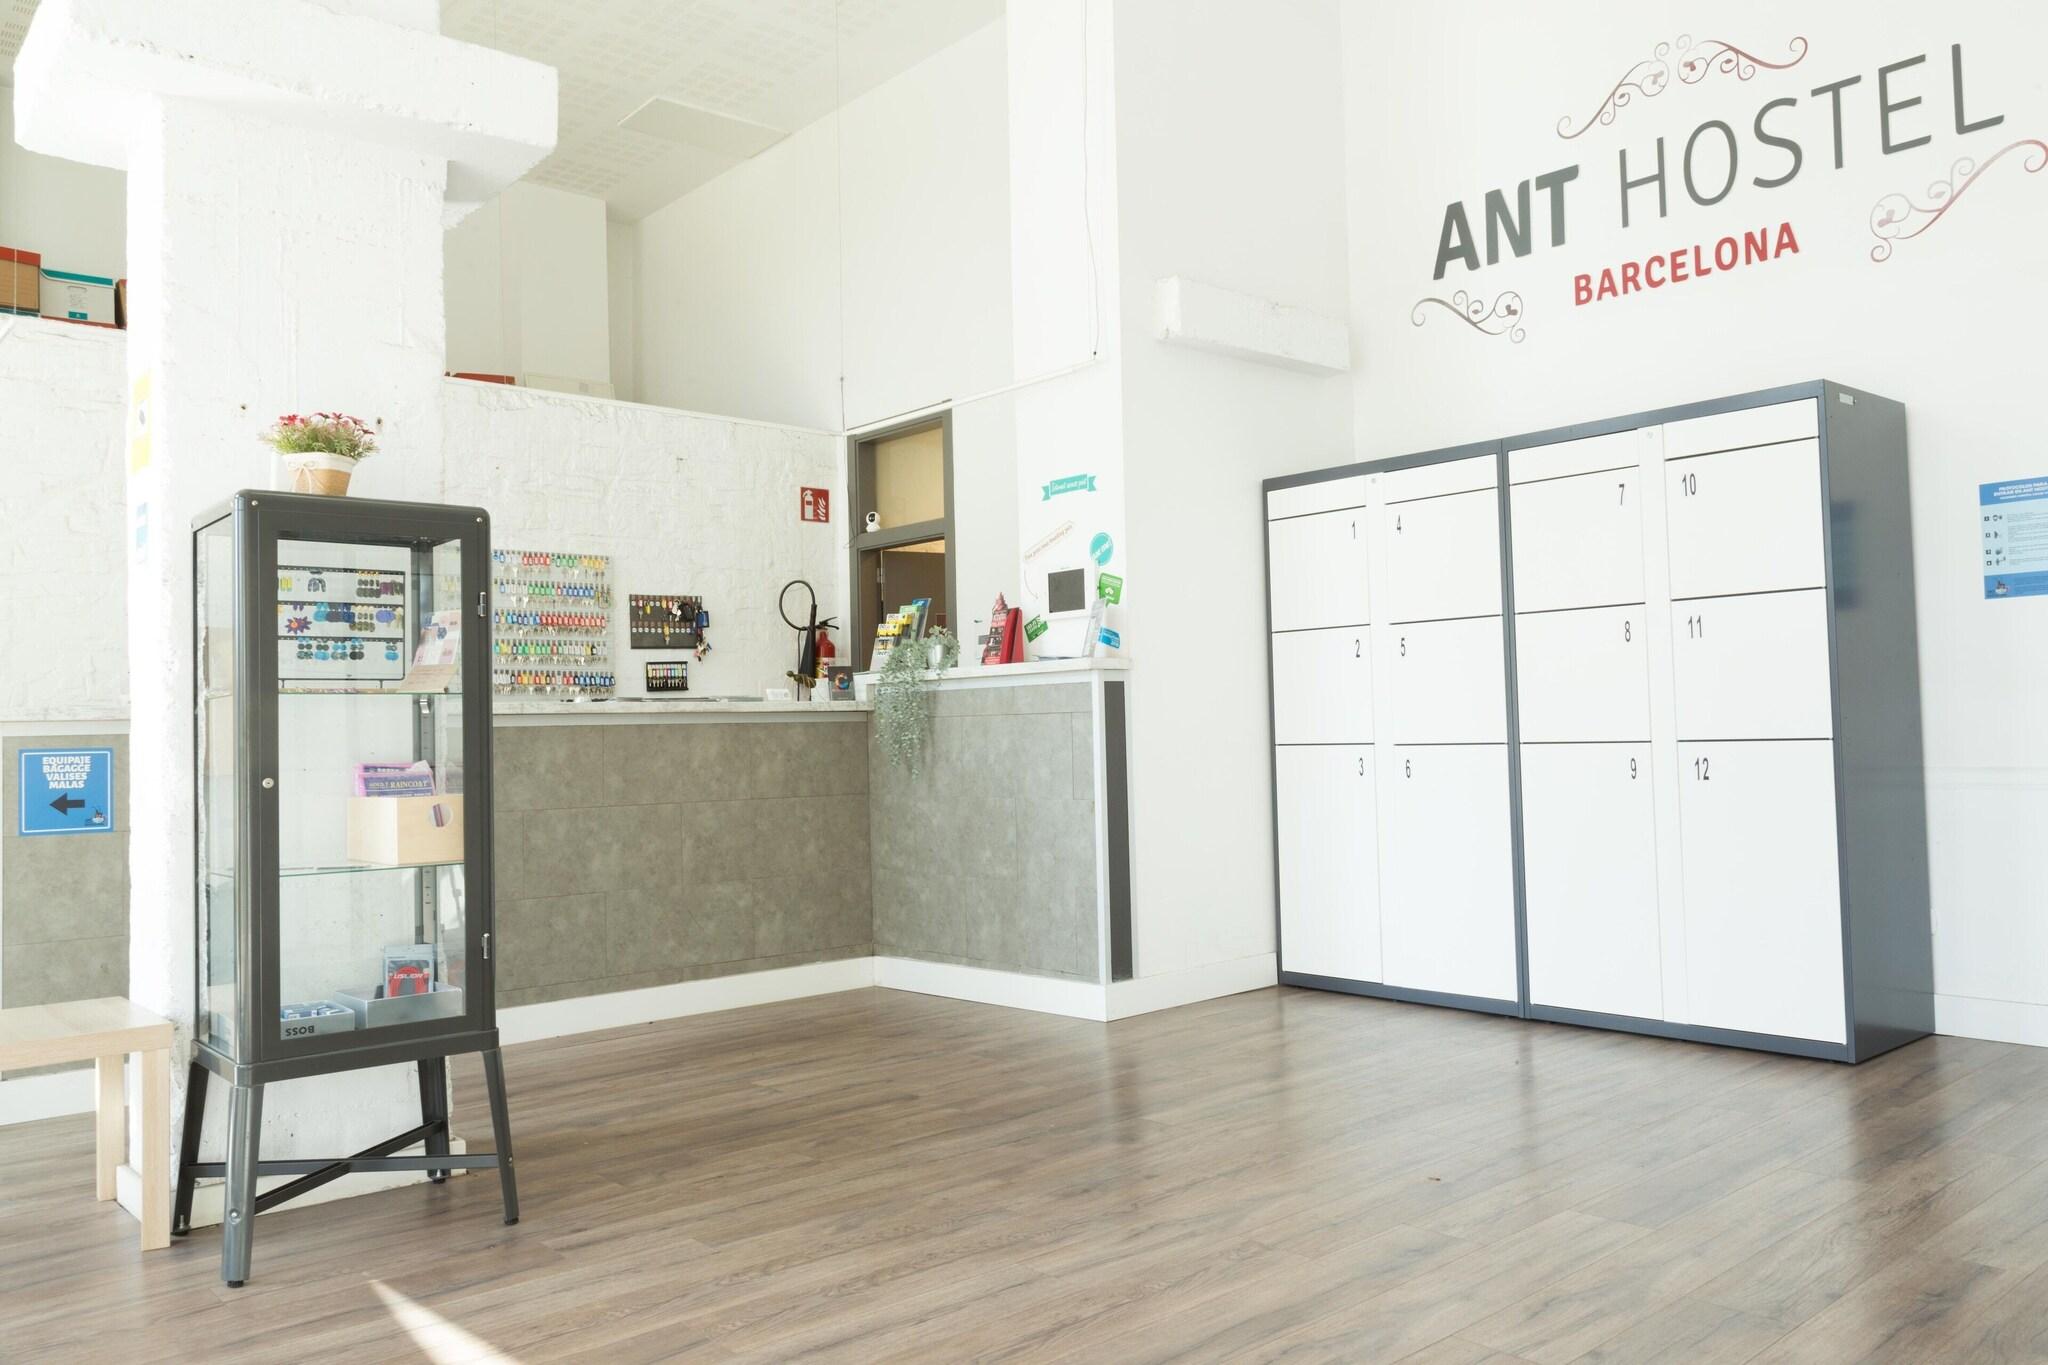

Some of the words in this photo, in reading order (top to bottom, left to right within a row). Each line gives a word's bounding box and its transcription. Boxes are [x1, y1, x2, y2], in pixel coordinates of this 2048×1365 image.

[1432, 164, 1580, 280] ANT
[1618, 43, 2005, 228] HOSTEL
[1573, 221, 1800, 306] BARCELONA
[1618, 483, 1625, 506] 7
[1682, 473, 1697, 496] 10
[1351, 521, 1356, 540] 1
[1396, 515, 1402, 534] 4
[1624, 621, 1632, 643] 8
[1687, 615, 1703, 639] 11
[1355, 639, 1361, 658] 2
[1400, 638, 1406, 657] 5
[42, 756, 91, 765] EQUIPAJE
[1358, 757, 1364, 777] 3
[1405, 759, 1411, 779] 6
[1630, 758, 1637, 780] 9
[1694, 757, 1710, 781] 12
[46, 772, 87, 781] VALISES
[49, 781, 85, 789] MALAS
[390, 780, 428, 788] RAINCOAT
[285, 1025, 315, 1036] BOSS
